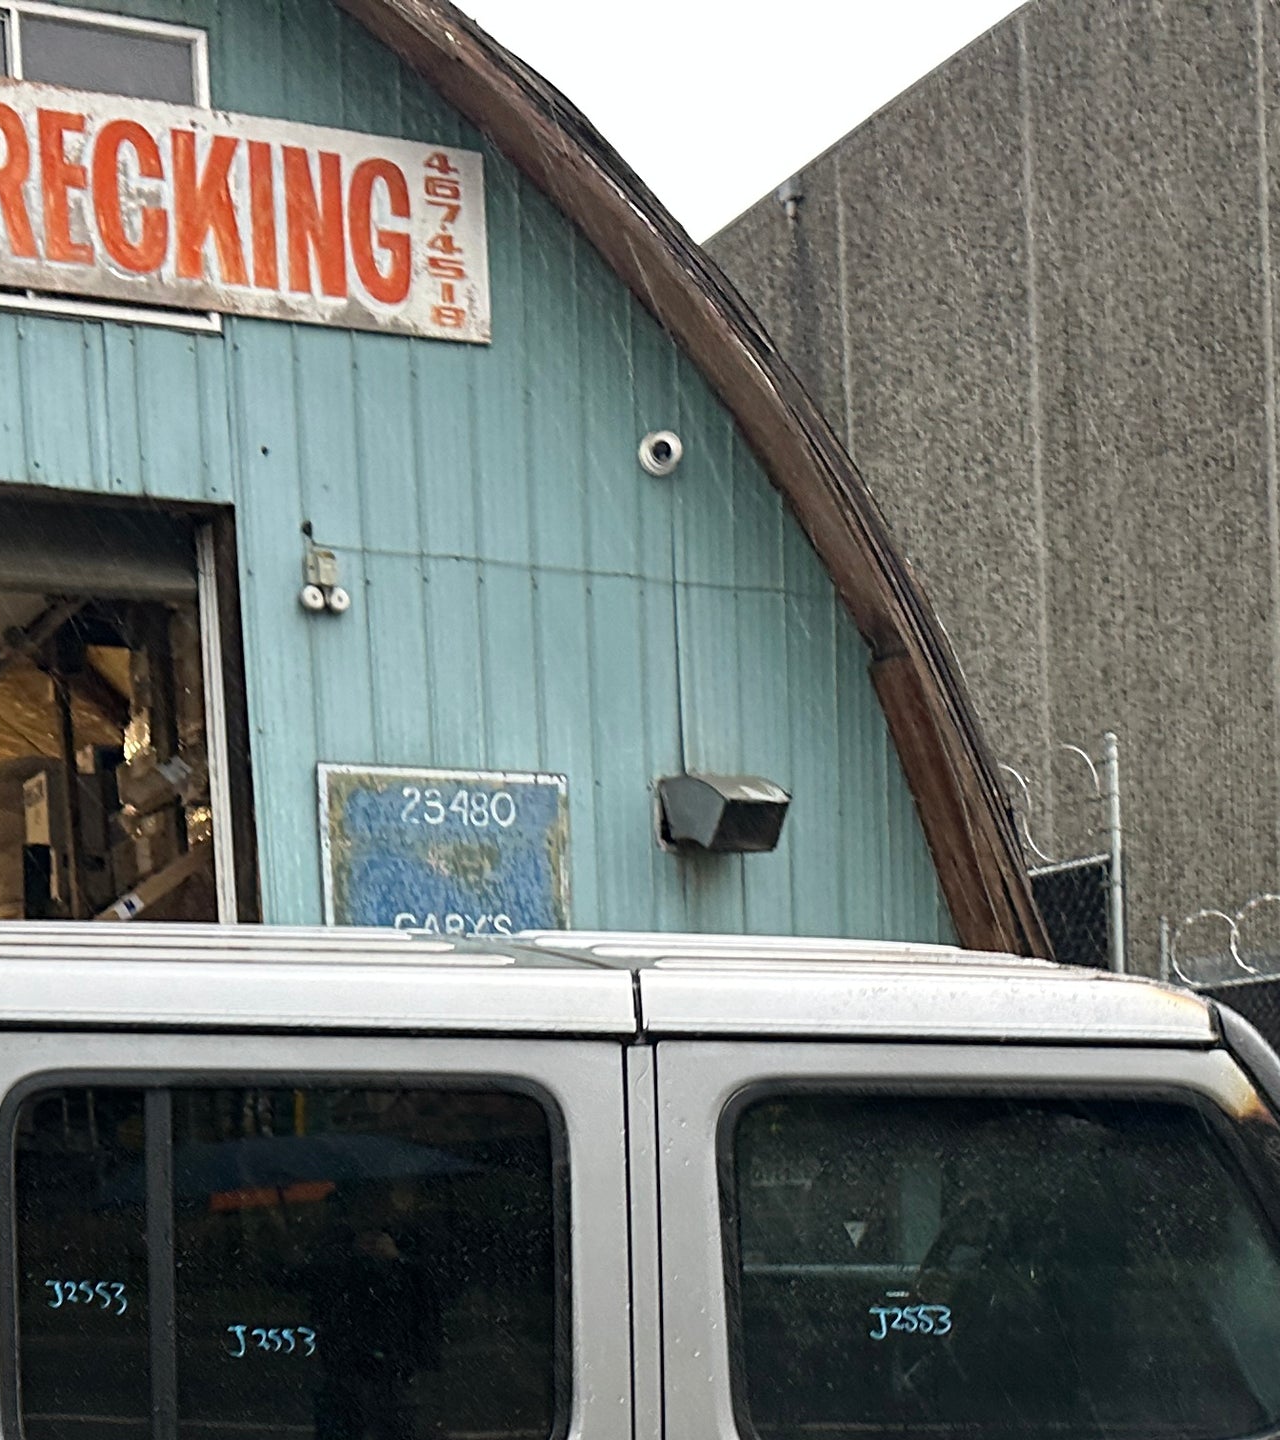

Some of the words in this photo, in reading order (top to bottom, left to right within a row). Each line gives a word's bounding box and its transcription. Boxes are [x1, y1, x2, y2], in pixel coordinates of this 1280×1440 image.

[401, 786, 516, 828] 23480
[45, 1279, 128, 1316] J2553
[869, 1304, 952, 1340] J2553
[227, 1324, 317, 1358] J2553
